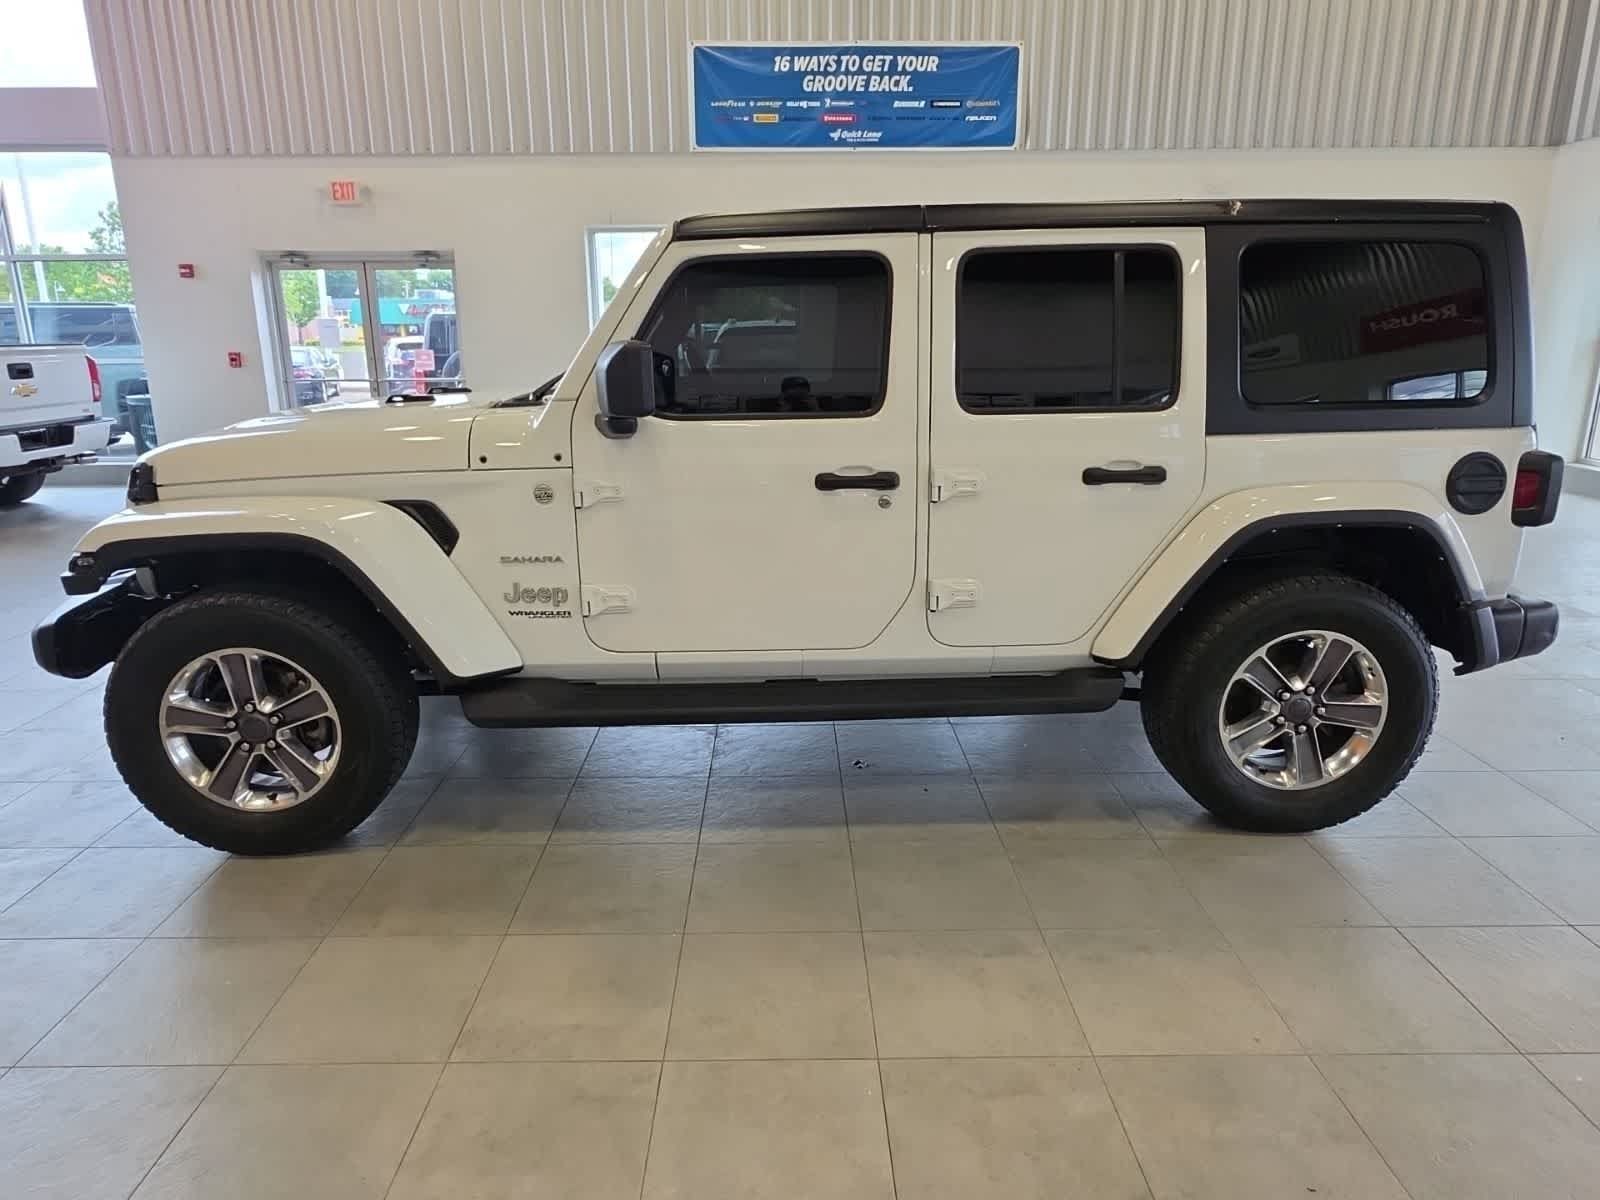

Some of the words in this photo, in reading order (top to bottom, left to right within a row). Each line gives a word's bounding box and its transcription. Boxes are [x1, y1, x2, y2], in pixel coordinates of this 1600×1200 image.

[773, 56, 790, 72] 16
[793, 56, 837, 72] WAYS
[840, 56, 860, 72] TO
[862, 56, 893, 72] GET
[896, 56, 939, 72] YOUR
[802, 75, 866, 92] GROOVE
[868, 75, 914, 92] BACK.
[332, 182, 355, 201] EXIT
[500, 555, 563, 563] SAHARA
[503, 582, 569, 607] Jeep
